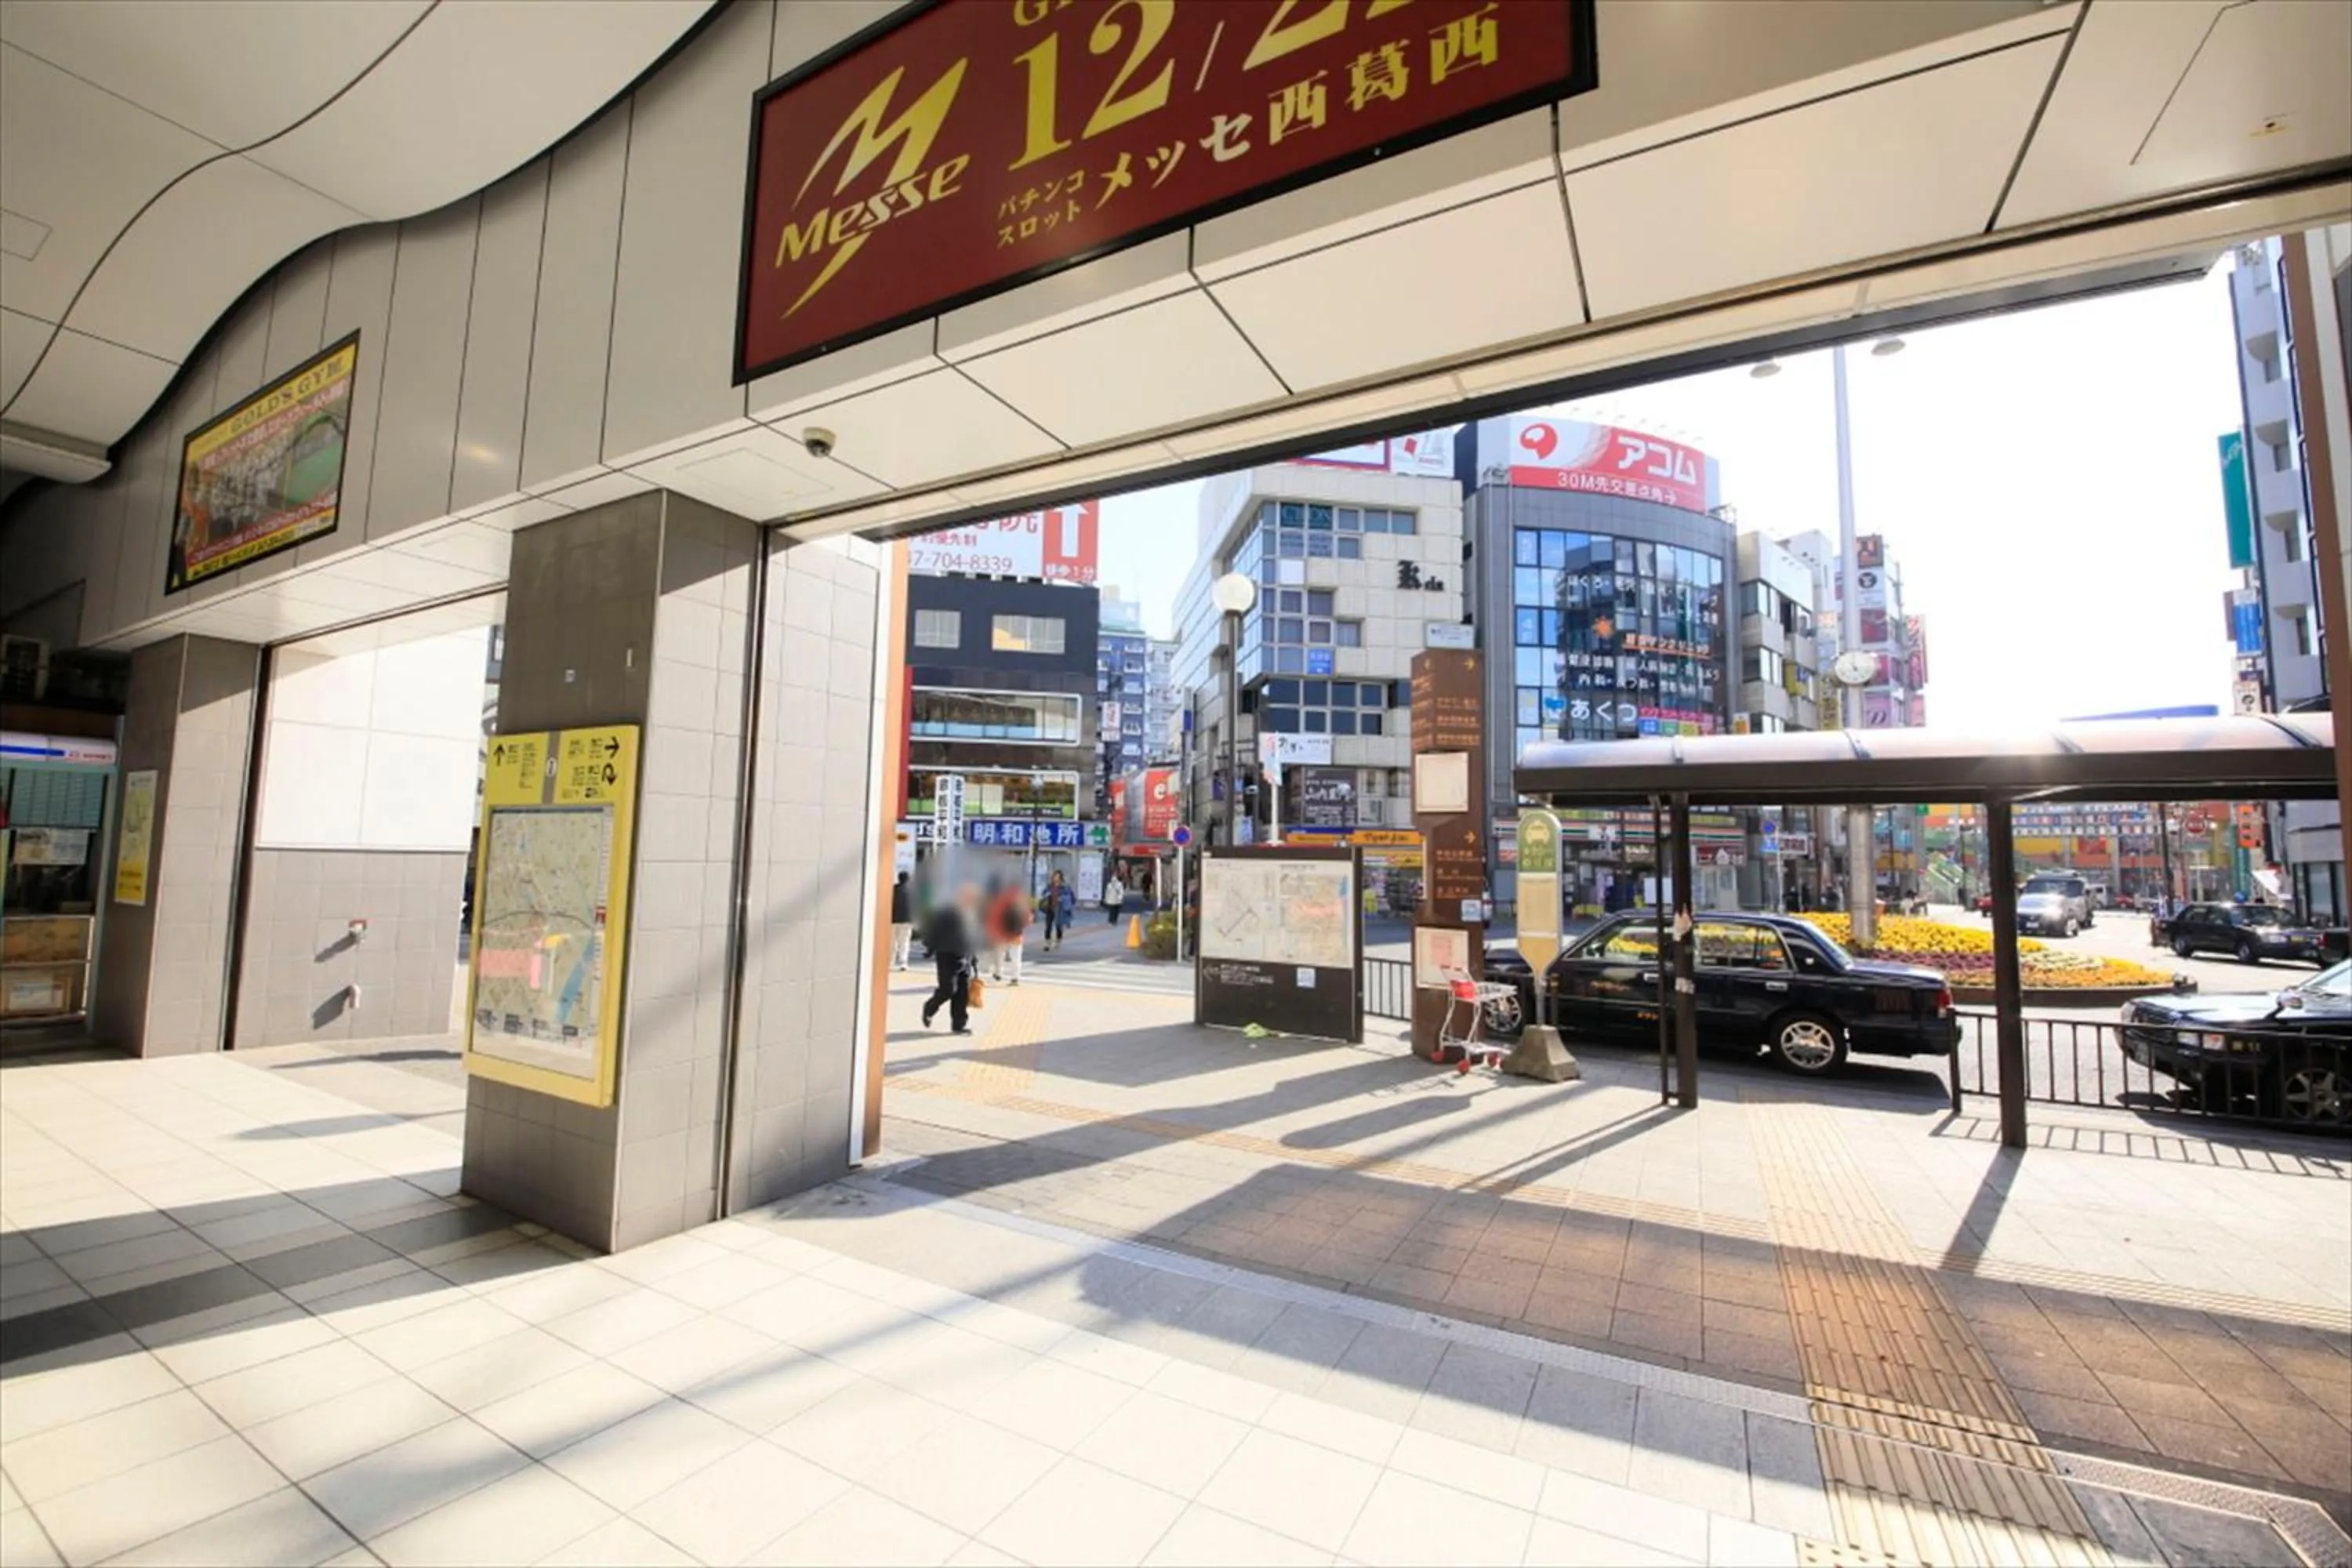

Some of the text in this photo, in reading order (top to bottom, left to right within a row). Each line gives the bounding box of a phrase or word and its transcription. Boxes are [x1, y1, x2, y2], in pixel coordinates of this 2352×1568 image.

[1095, 2, 1499, 210] メッセ西葛西
[775, 154, 971, 268] Messe
[997, 169, 1084, 219] パチンコ
[996, 199, 1082, 249] スロット
[1617, 433, 1697, 485] アコム
[1570, 699, 1639, 723] あくつ
[973, 822, 1080, 846] 明和地所
